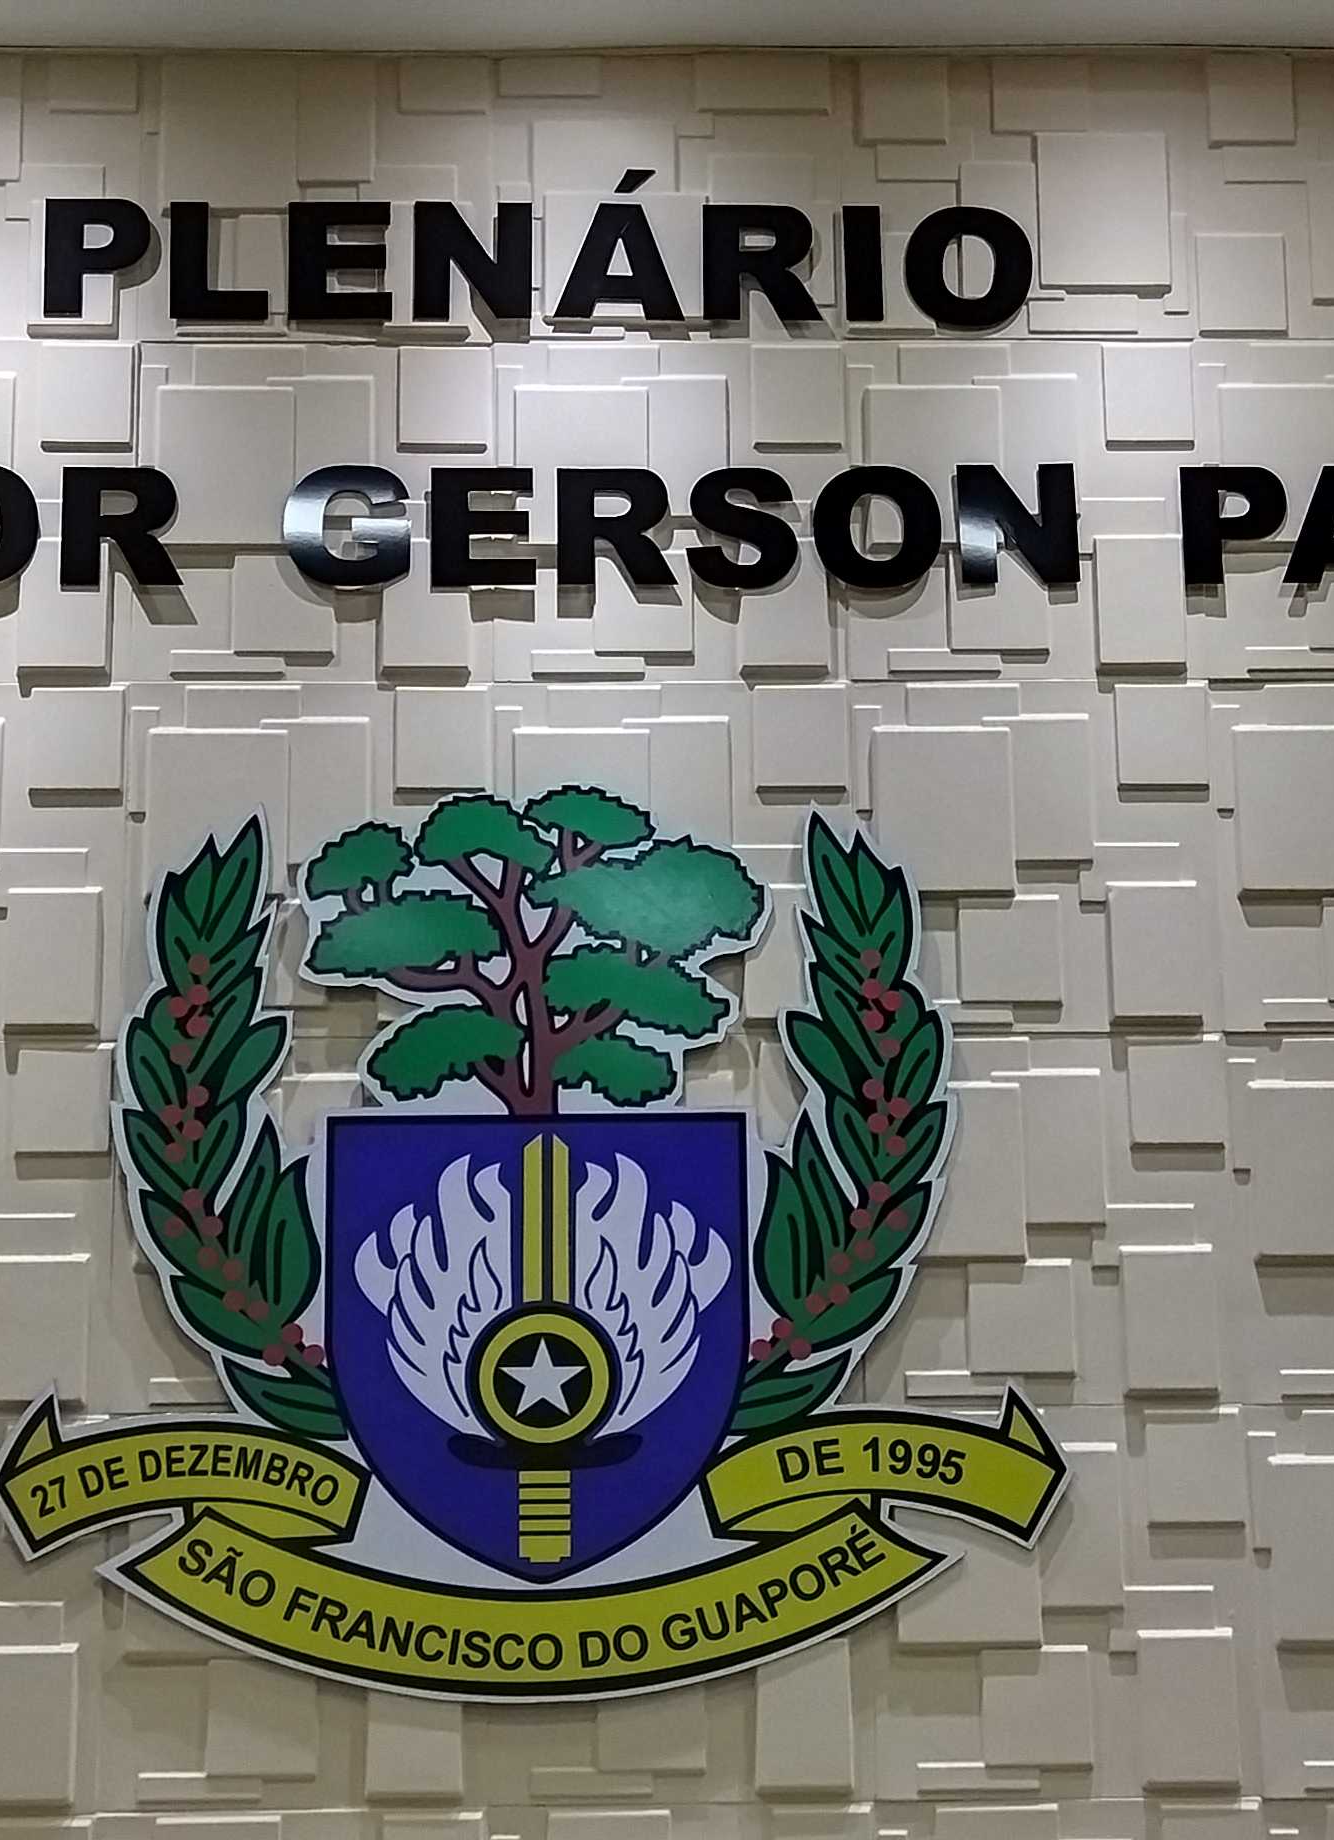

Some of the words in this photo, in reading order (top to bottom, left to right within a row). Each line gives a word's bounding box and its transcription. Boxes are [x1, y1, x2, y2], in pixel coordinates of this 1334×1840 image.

[43, 169, 1034, 329] PLENÁRIO
[283, 462, 1081, 590] GERSON
[30, 1476, 67, 1518] 27
[78, 1456, 129, 1498] DE
[138, 1444, 340, 1507] DEZEMBRO
[776, 1438, 845, 1484] DE
[862, 1436, 967, 1485] 1995
[178, 1538, 276, 1607] SÃO
[283, 1587, 563, 1671] FRANCISCO
[579, 1624, 649, 1668] DO
[661, 1525, 887, 1651] GUAPORÉ
